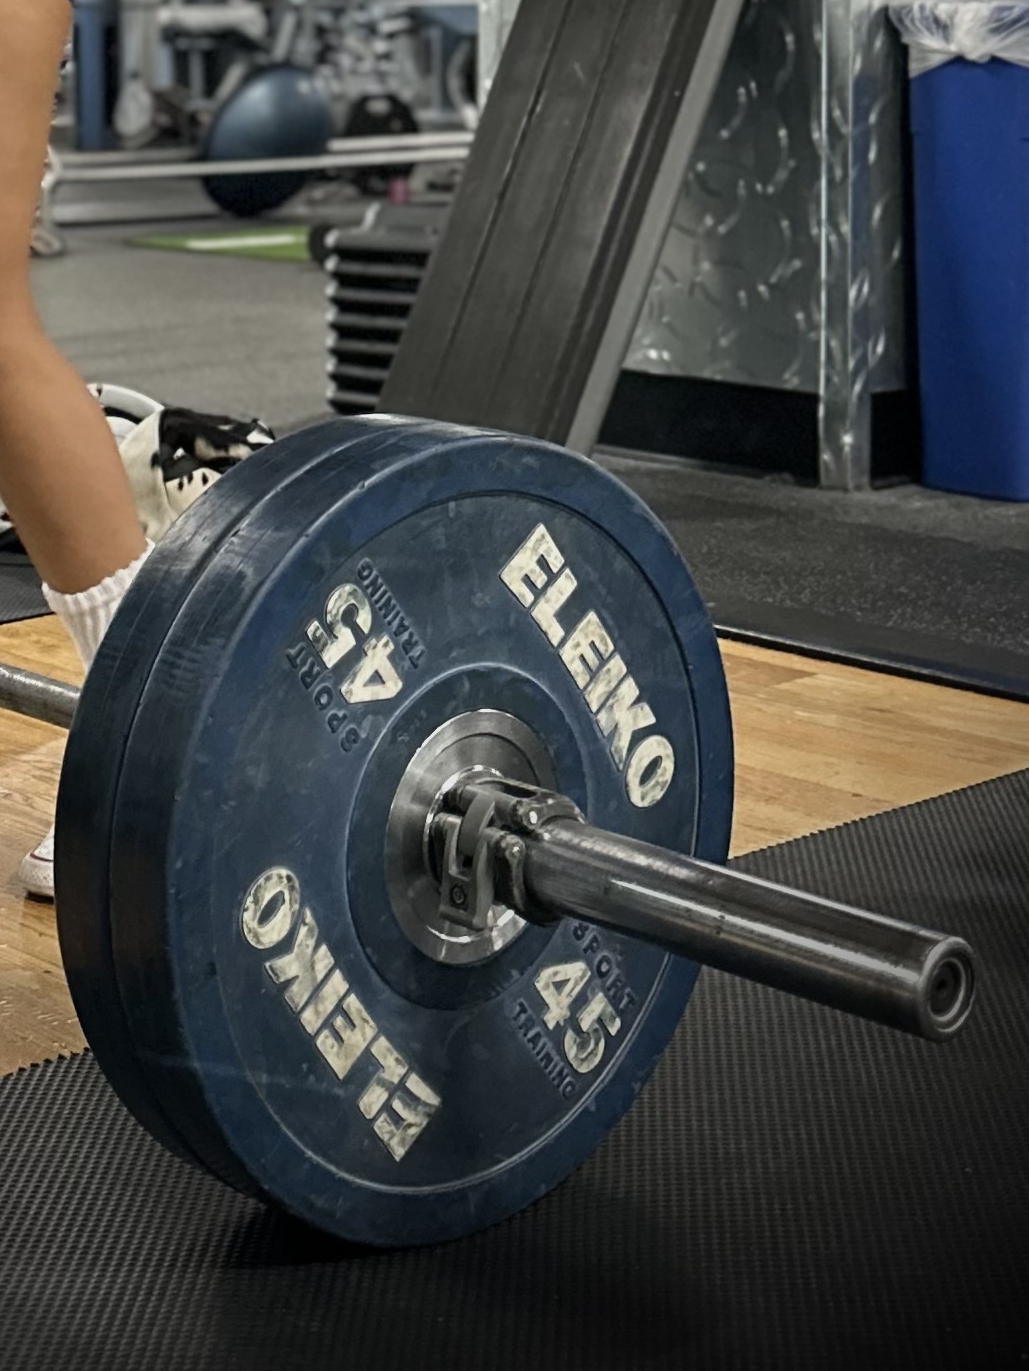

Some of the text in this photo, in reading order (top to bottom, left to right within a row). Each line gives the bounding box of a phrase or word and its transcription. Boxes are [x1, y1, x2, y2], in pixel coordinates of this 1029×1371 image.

[305, 582, 404, 705] 45
[357, 557, 426, 670] TRAINING
[500, 522, 675, 809] ELEIKO
[286, 642, 361, 753] SPORT
[242, 866, 442, 1164] ELEIKO
[534, 961, 622, 1074] 45
[572, 922, 638, 1010] SPORT
[512, 1000, 577, 1102] TRAINING
